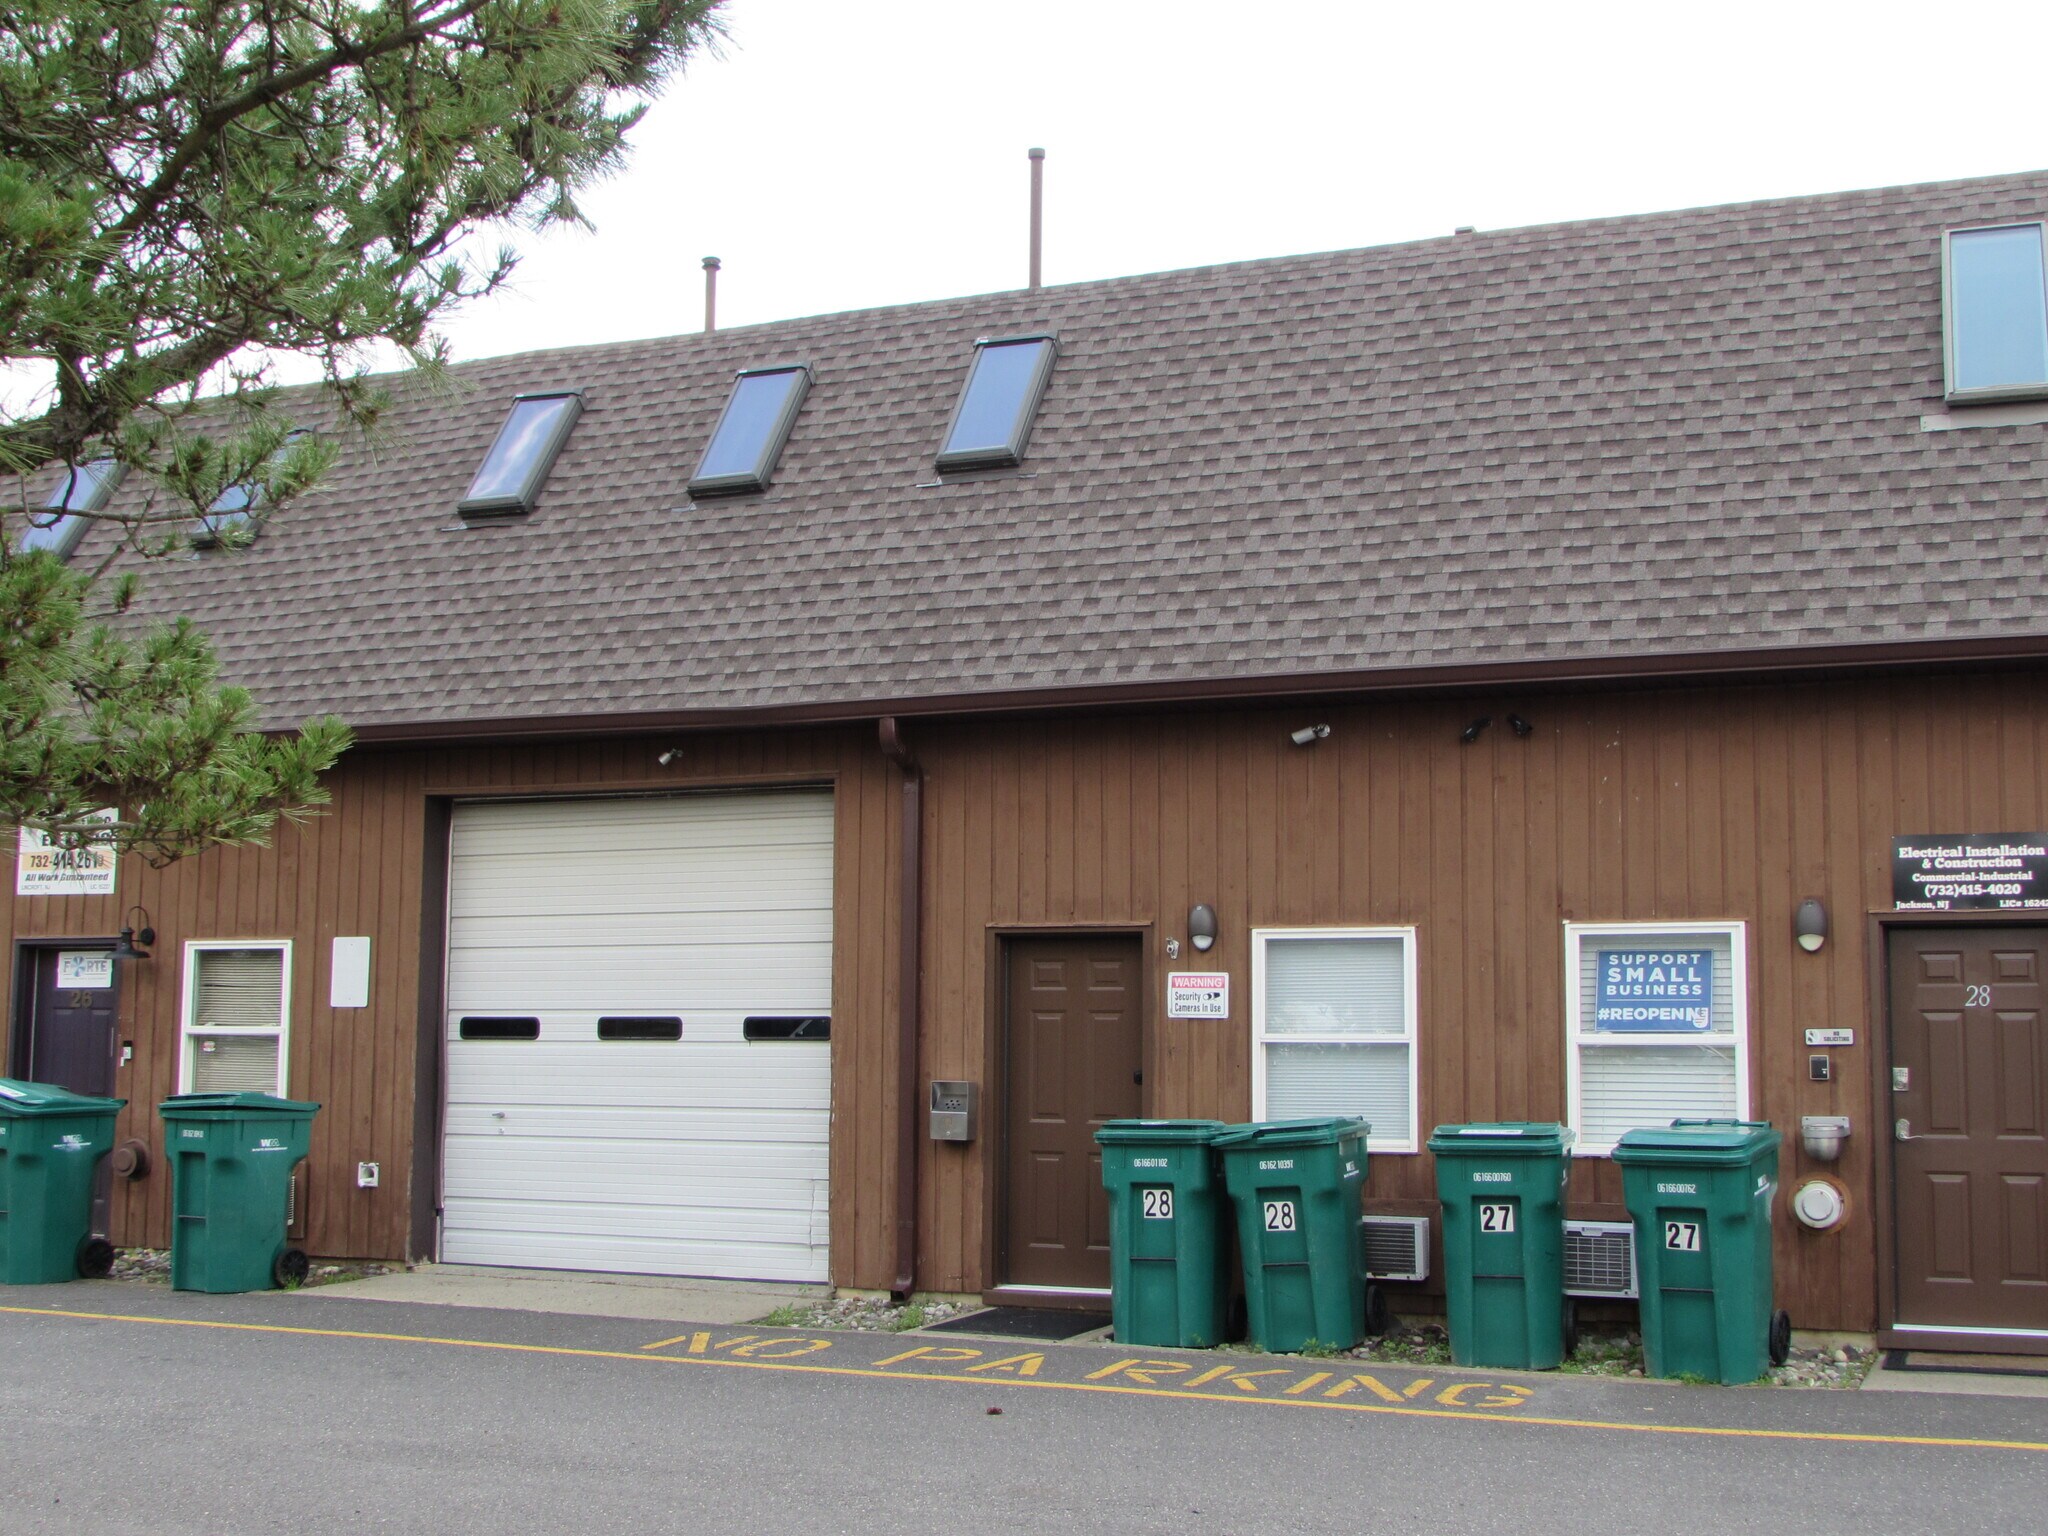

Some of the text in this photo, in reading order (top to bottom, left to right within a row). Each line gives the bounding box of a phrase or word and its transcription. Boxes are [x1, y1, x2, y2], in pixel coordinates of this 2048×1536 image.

[1899, 845, 2045, 858] Electrical Installation
[1922, 857, 2023, 869] & Construction
[25, 872, 109, 882] All Work Guaranteed
[1912, 871, 2033, 882] Commercial-Industrial
[1924, 883, 2022, 898] (732)415-4020
[1896, 900, 1935, 910] Jackson,
[1937, 900, 1949, 910] NJ
[1609, 954, 1701, 965] SUPPORT
[1607, 967, 1702, 982] SMALL
[1174, 977, 1222, 988] WARNING
[1174, 991, 1201, 1002] Security
[1606, 984, 1702, 996] BUSINESS
[1965, 985, 1990, 1006] 28
[70, 992, 92, 1008] 26
[1174, 1002, 1221, 1013] Cameras In Use
[1144, 1190, 1171, 1217] 28
[1266, 1202, 1293, 1230] 28
[1482, 1206, 1511, 1231] 27
[1667, 1224, 1697, 1249] 27
[639, 1332, 1535, 1409] NO PARKING
